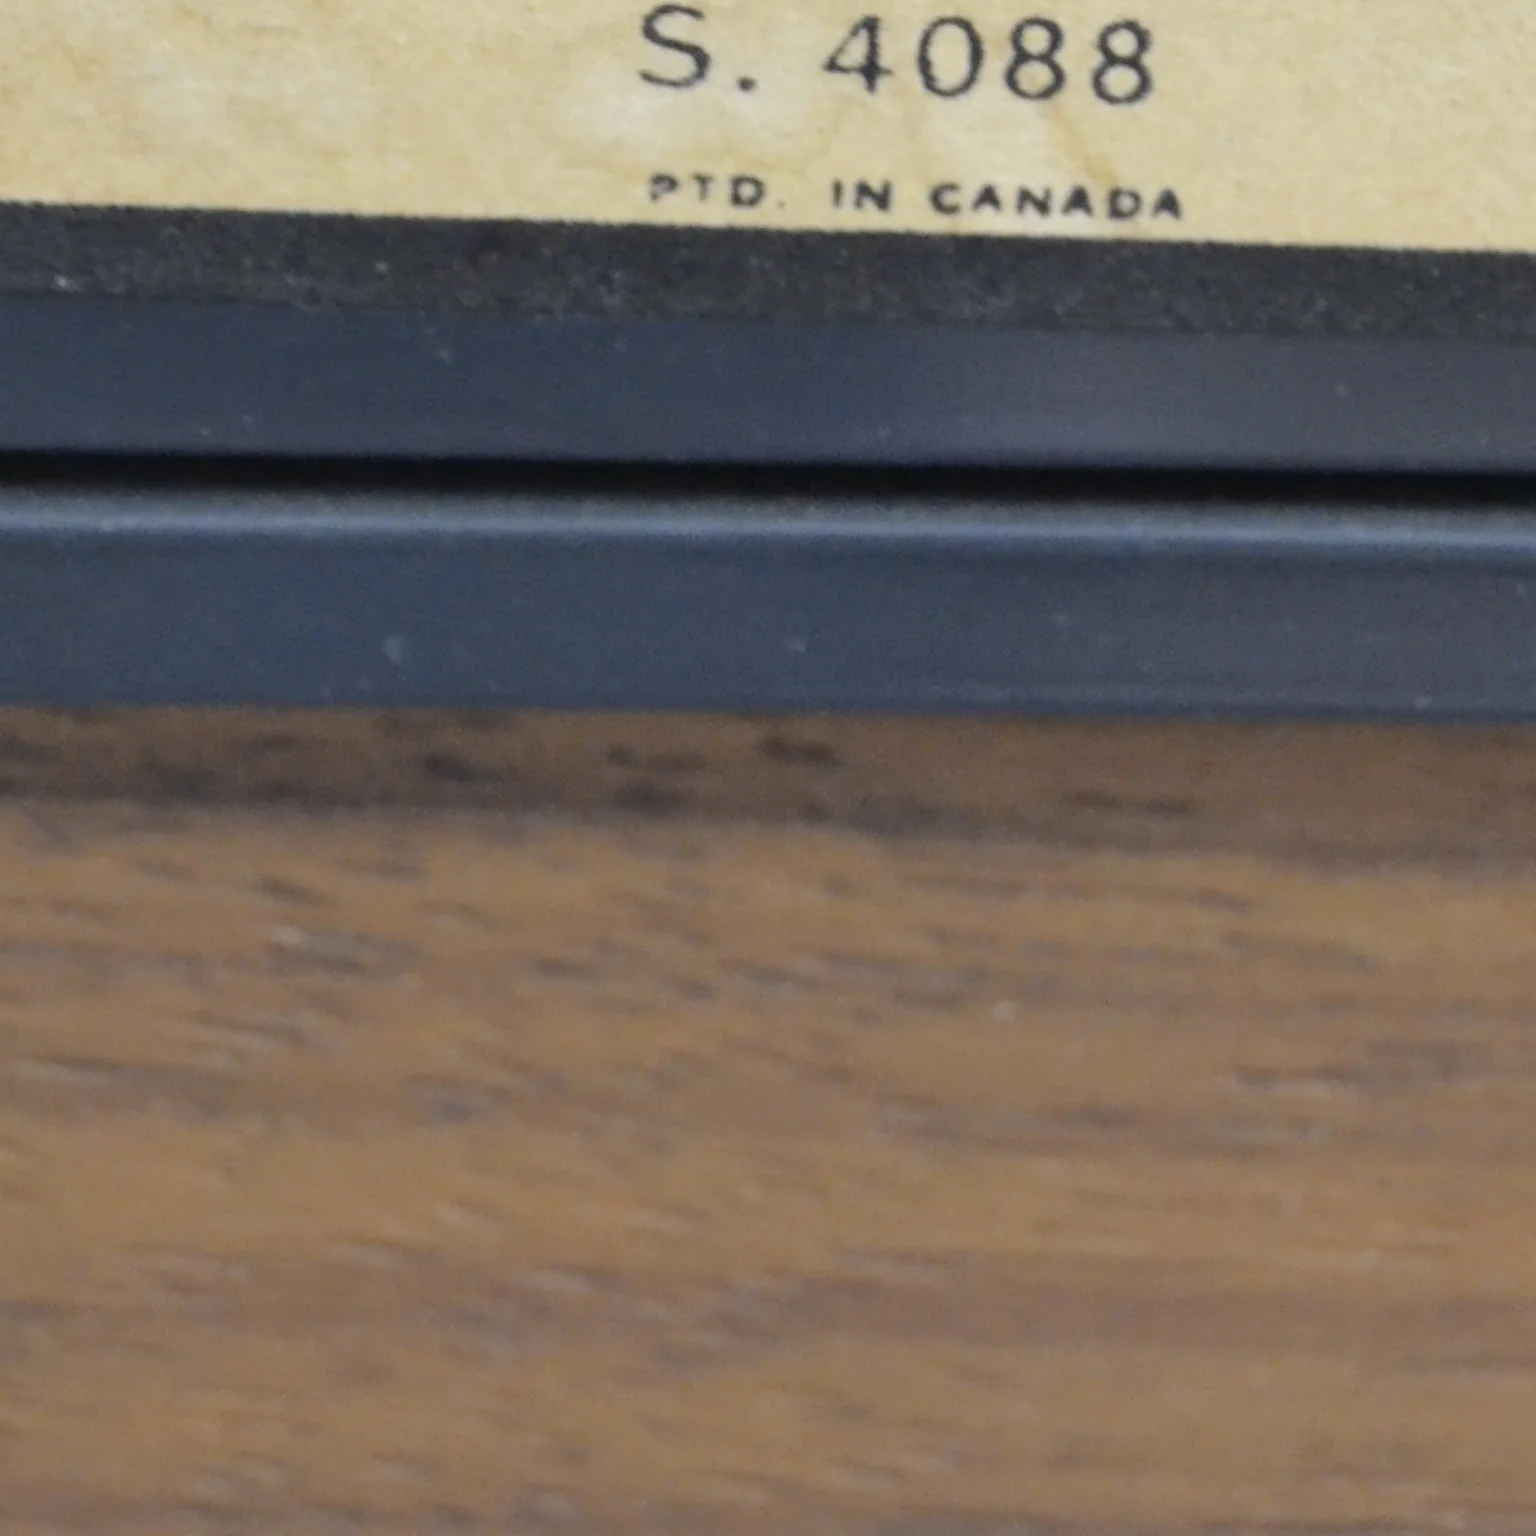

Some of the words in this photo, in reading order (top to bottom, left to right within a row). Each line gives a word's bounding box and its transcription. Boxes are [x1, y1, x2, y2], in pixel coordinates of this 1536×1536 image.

[638, 3, 759, 93] S.
[822, 15, 1154, 106] 4088
[648, 173, 786, 209] PTD.
[831, 180, 892, 212] IN
[929, 182, 1183, 221] CANADA
